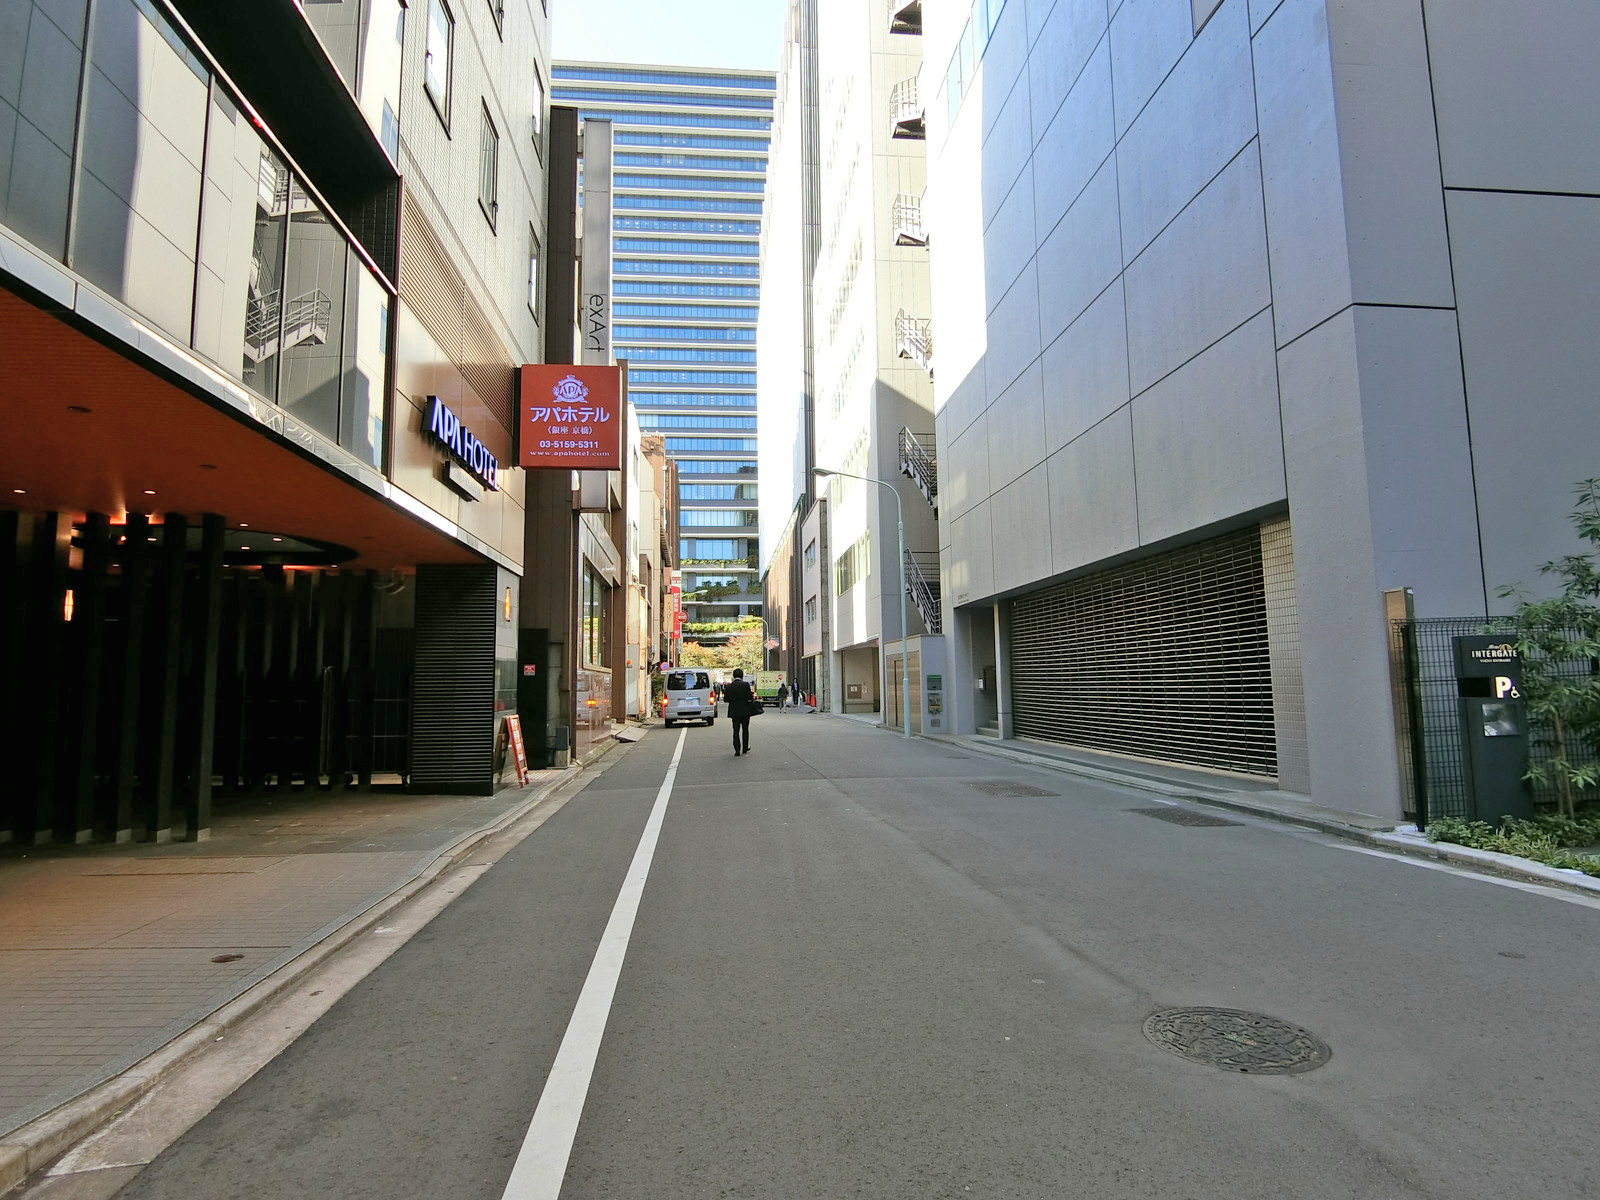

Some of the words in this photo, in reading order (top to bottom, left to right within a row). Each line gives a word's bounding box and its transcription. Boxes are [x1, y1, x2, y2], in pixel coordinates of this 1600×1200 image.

[585, 294, 606, 353] exArt
[530, 406, 610, 423] アパホテル
[539, 440, 599, 449] 03-5159-5311
[463, 427, 500, 491] HOTEL
[1471, 650, 1518, 658] INTERGATE
[1495, 676, 1512, 699] P
